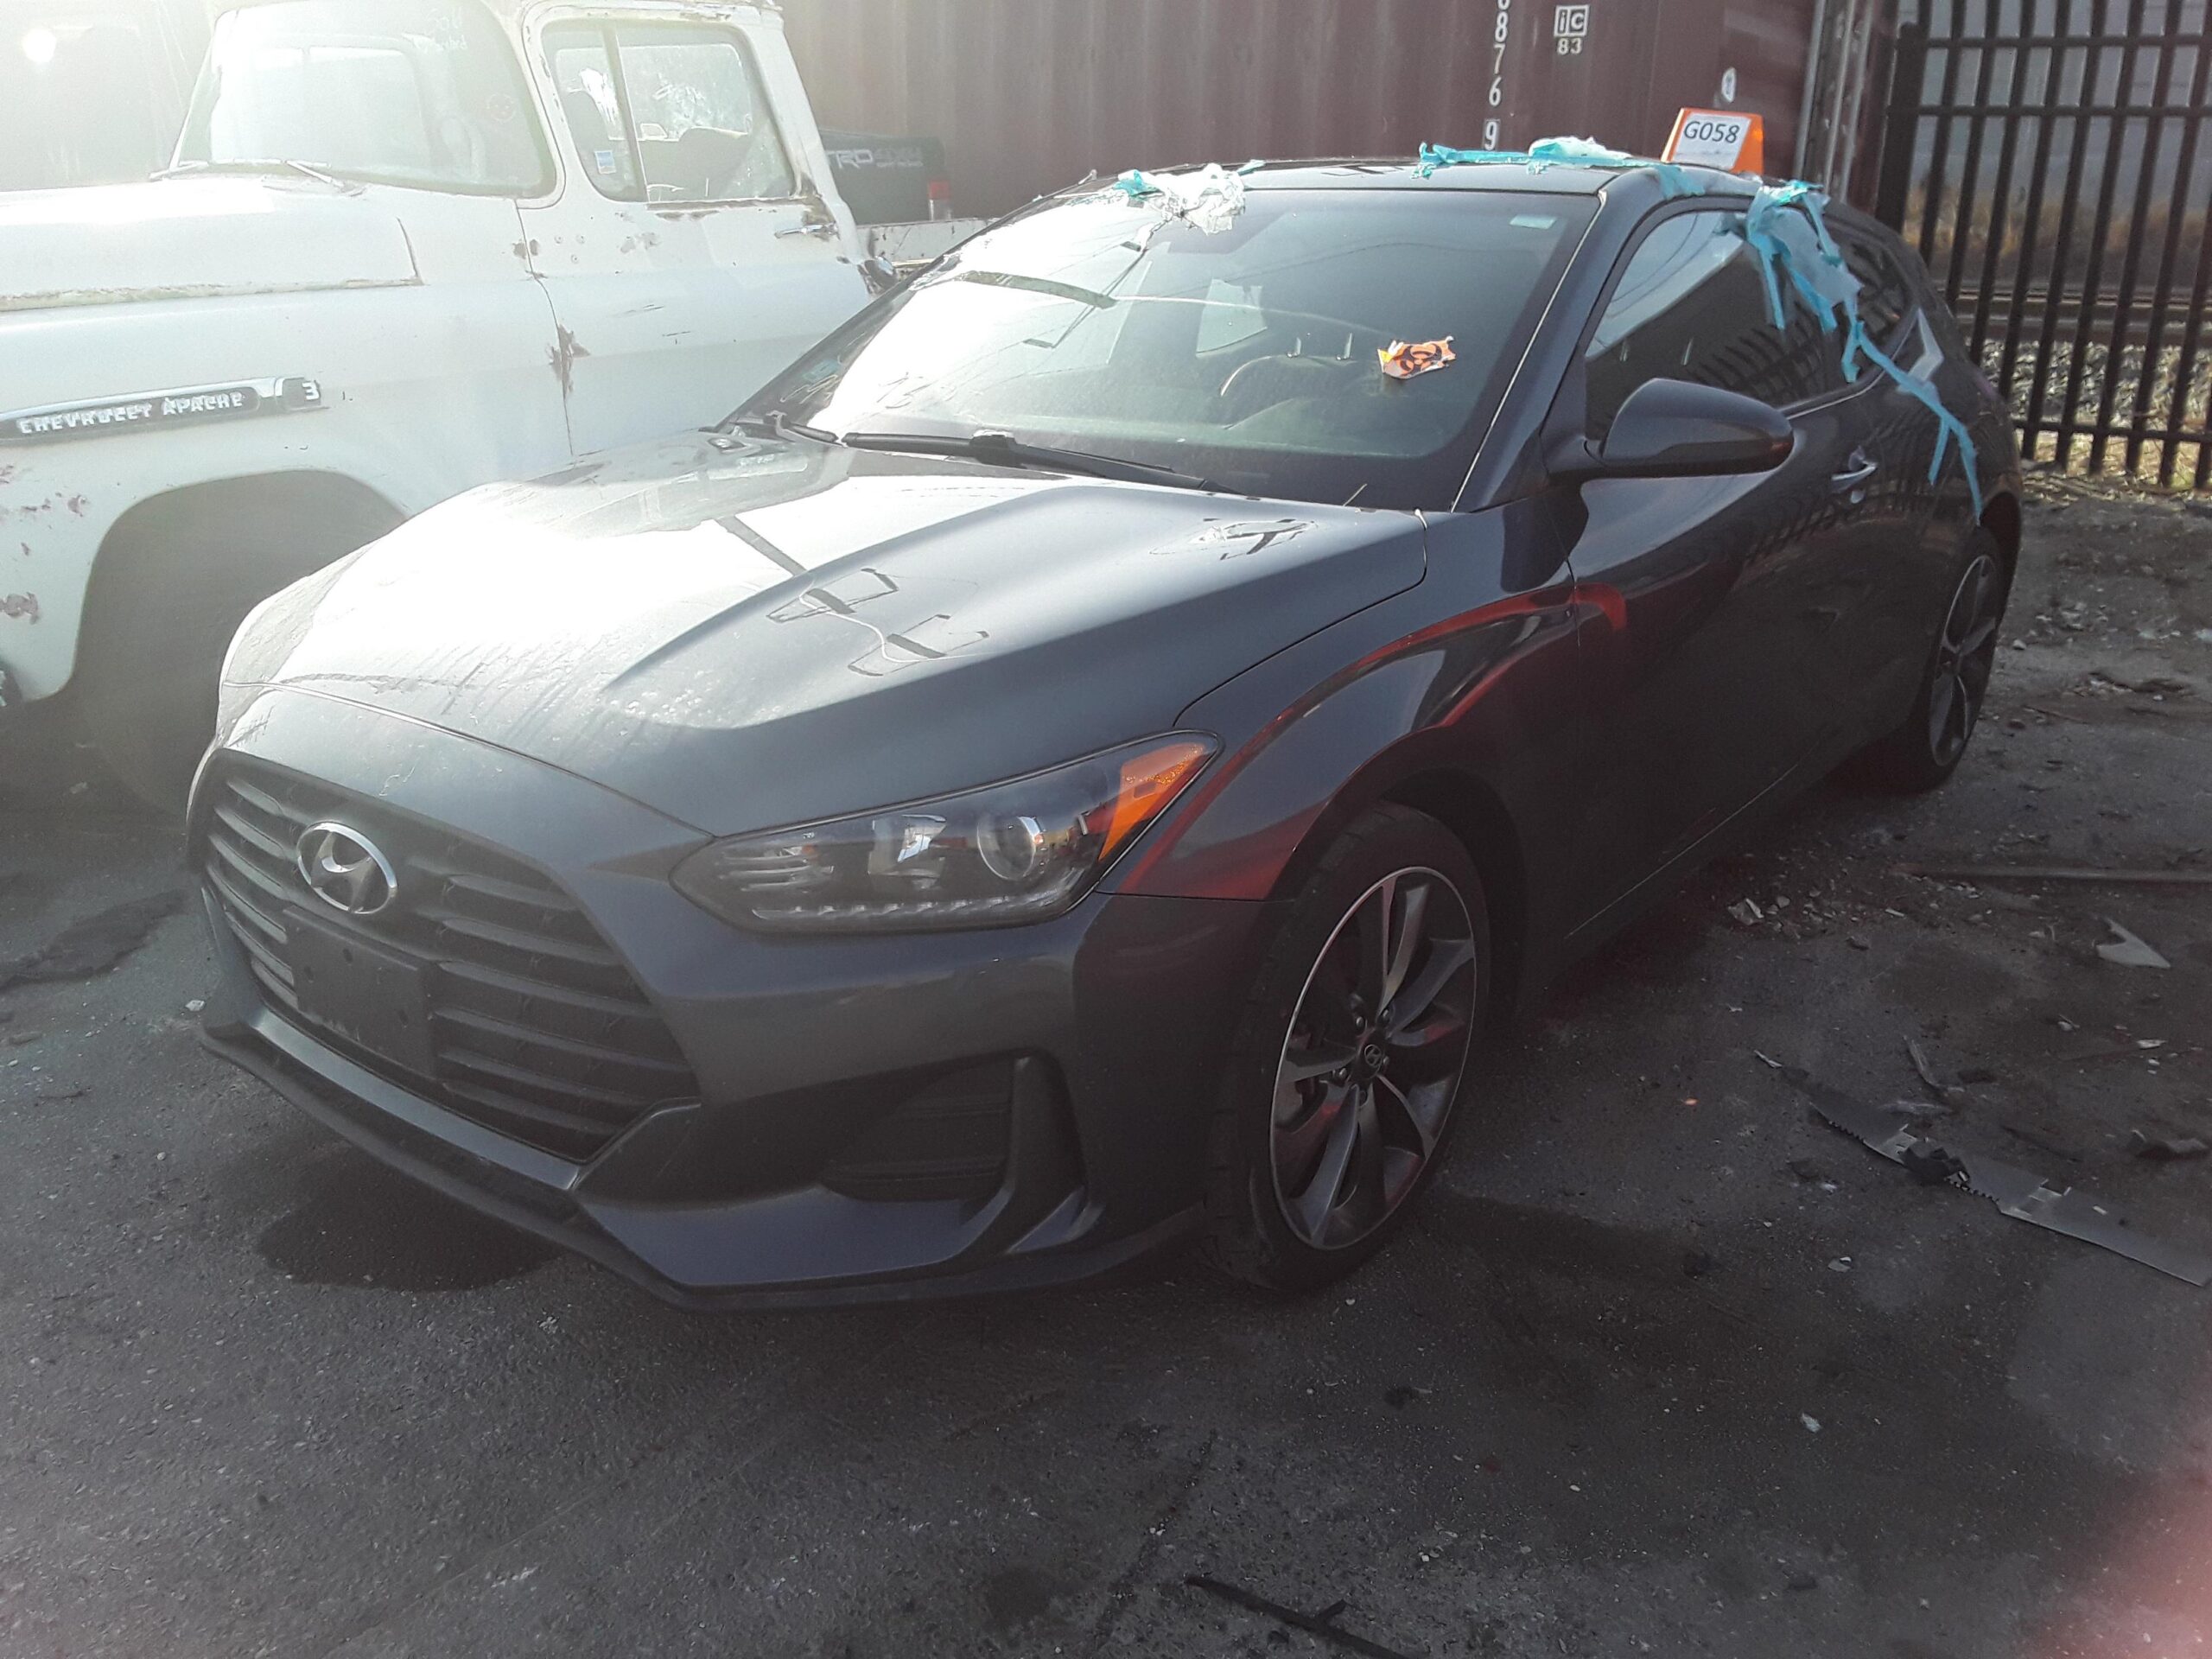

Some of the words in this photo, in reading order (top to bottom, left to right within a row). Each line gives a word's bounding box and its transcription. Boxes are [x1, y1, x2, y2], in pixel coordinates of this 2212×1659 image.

[1489, 0, 1510, 105] 876
[1557, 37, 1582, 54] 83
[1684, 121, 1740, 143] G058
[17, 401, 151, 434] CHEVROLET
[162, 391, 246, 416] APACHE
